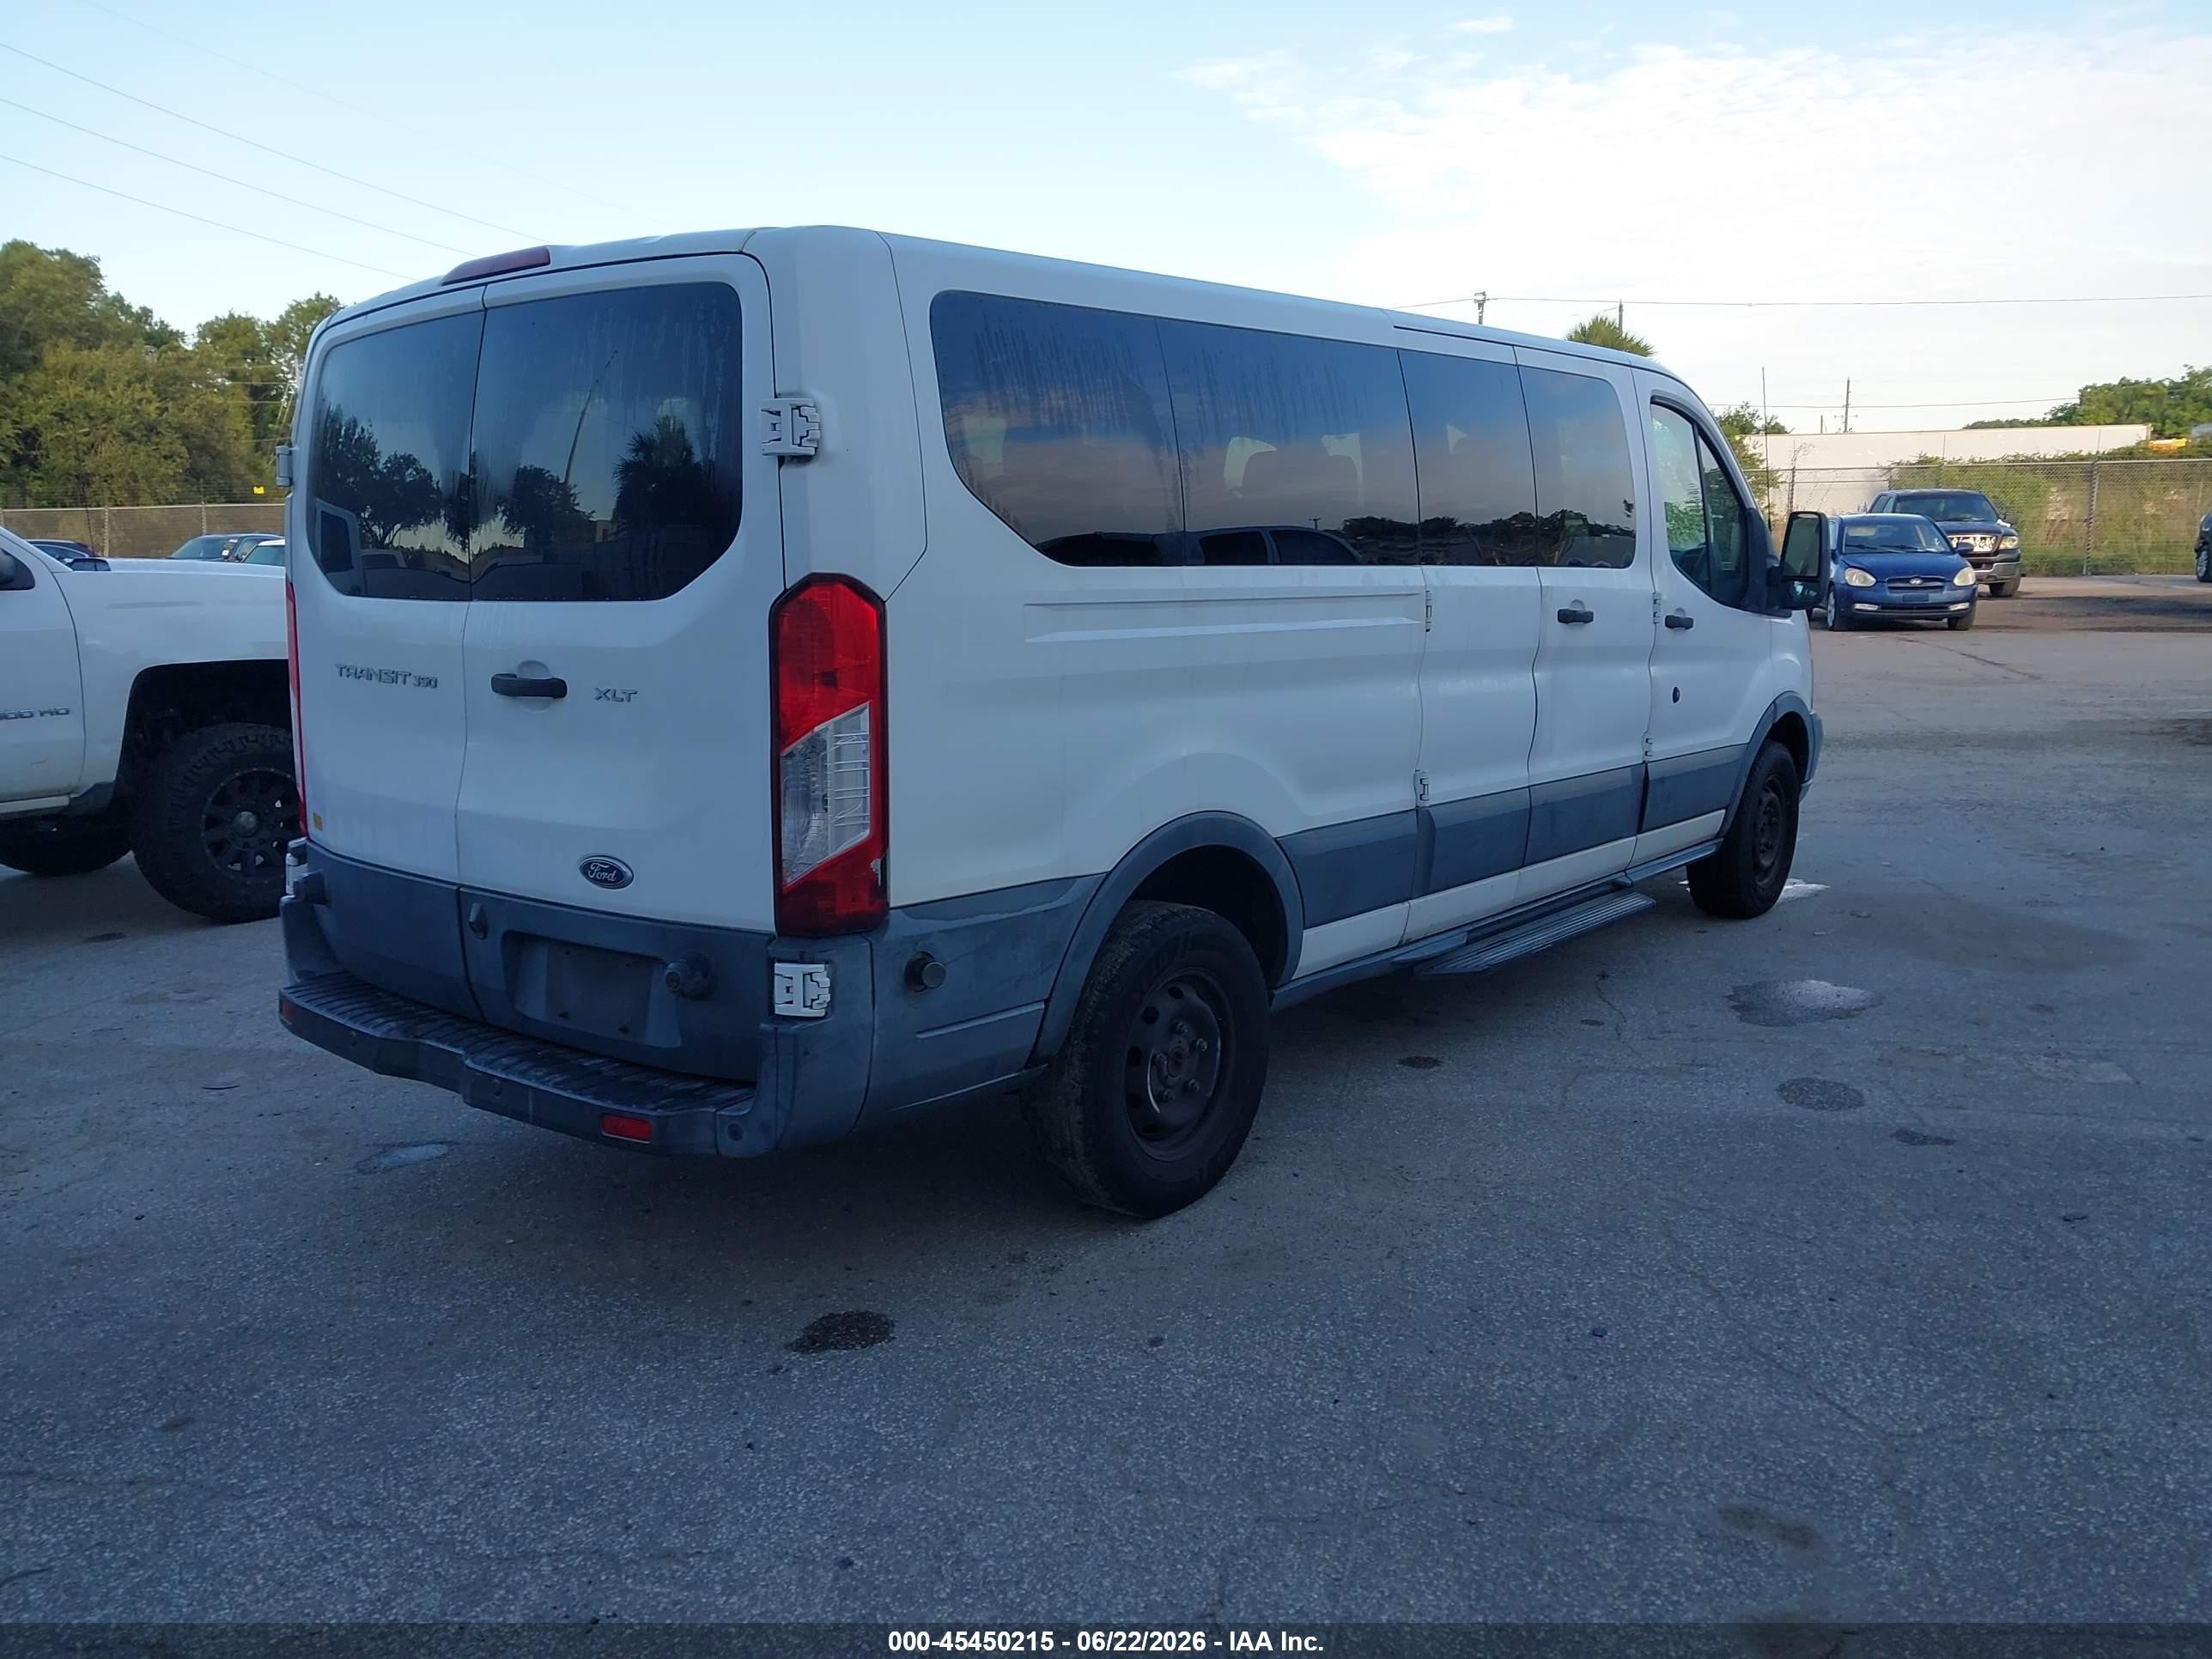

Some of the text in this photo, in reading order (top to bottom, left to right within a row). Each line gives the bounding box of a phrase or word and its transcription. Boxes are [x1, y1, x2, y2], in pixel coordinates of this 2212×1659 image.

[335, 664, 438, 688] TRANSIT 350
[594, 687, 638, 702] XLT
[39, 707, 70, 717] HD
[587, 862, 617, 882] Ford
